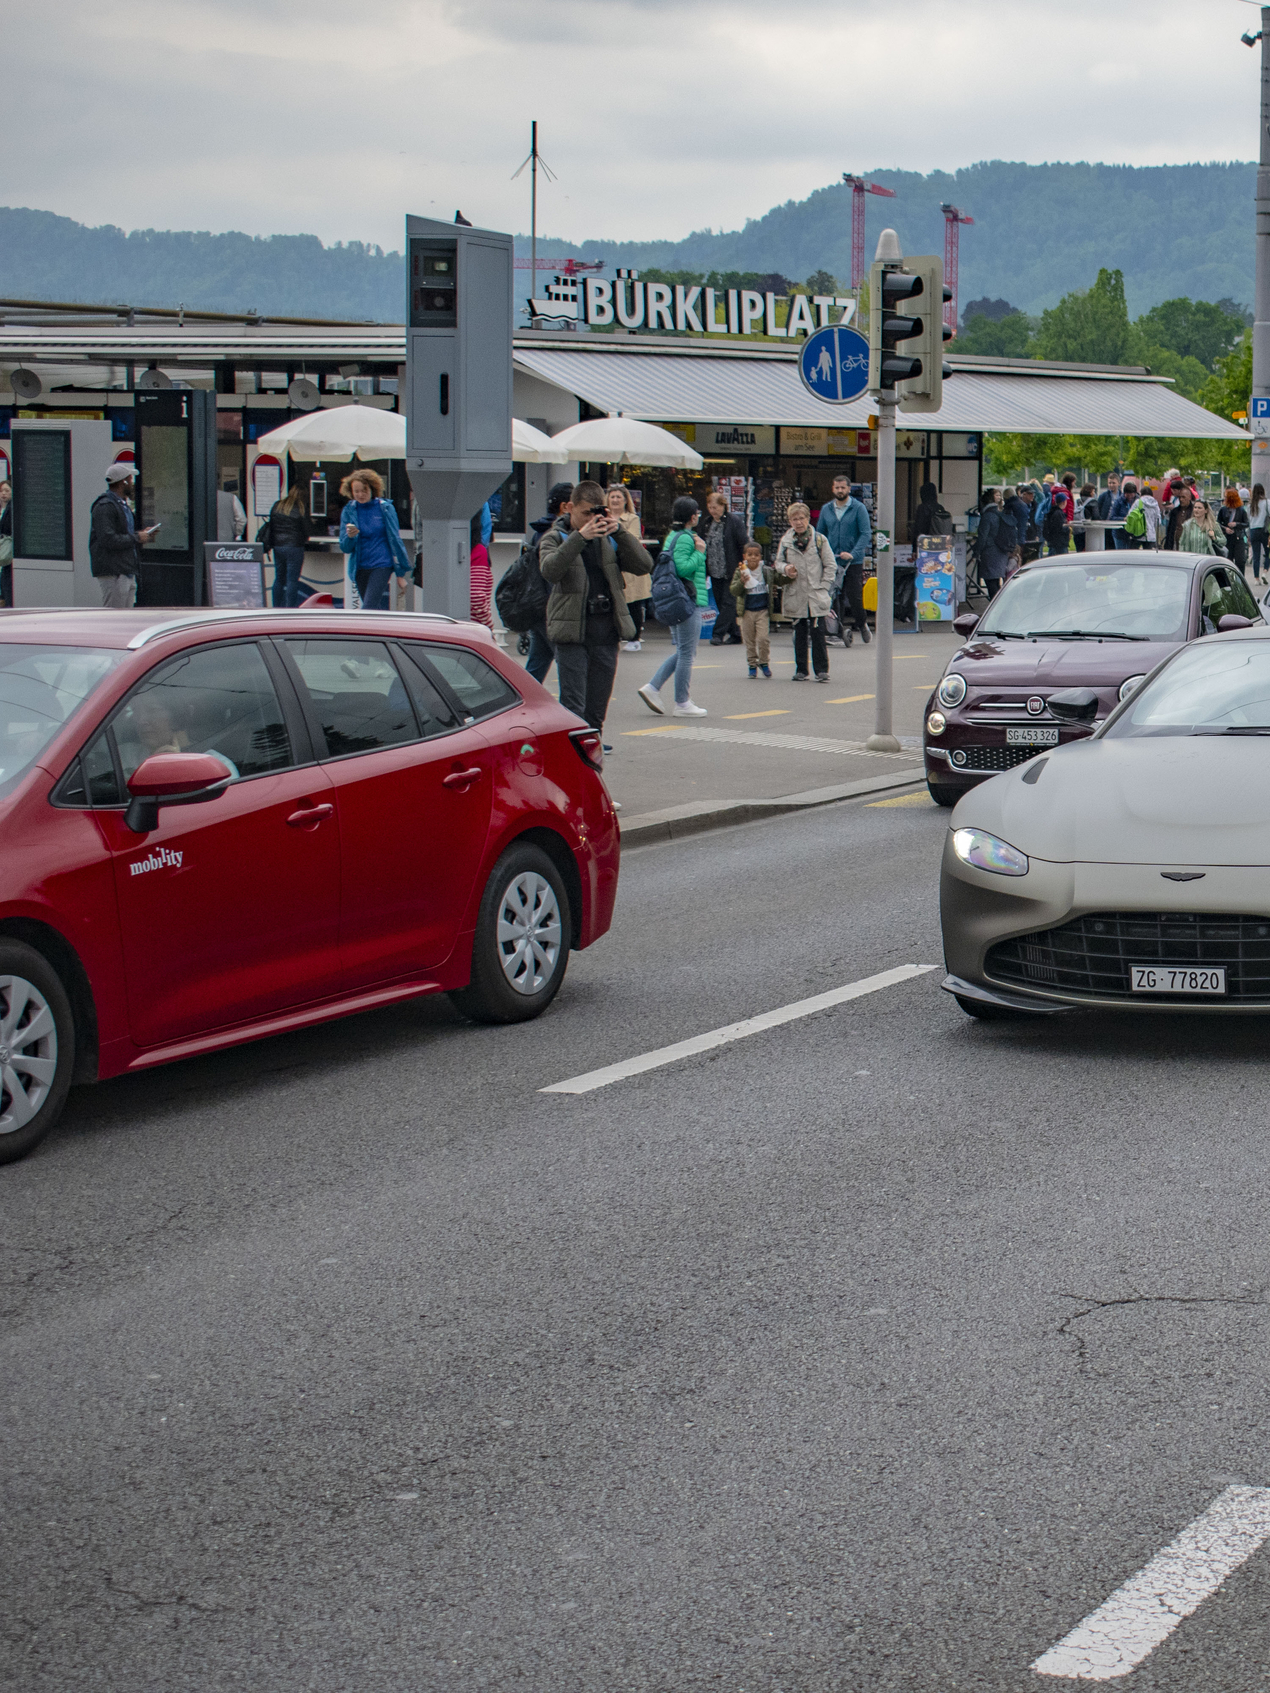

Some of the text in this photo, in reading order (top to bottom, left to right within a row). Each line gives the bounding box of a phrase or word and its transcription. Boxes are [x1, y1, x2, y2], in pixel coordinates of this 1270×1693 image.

[583, 268, 857, 338] BÜRKLIPLATZ
[1257, 400, 1268, 416] P
[715, 427, 756, 445] LAVAZZA
[786, 432, 803, 440] Bistro
[810, 432, 822, 440] Grill
[215, 548, 254, 560] Coca-Cola
[1030, 702, 1041, 710] FIAT
[129, 846, 183, 876] mobility
